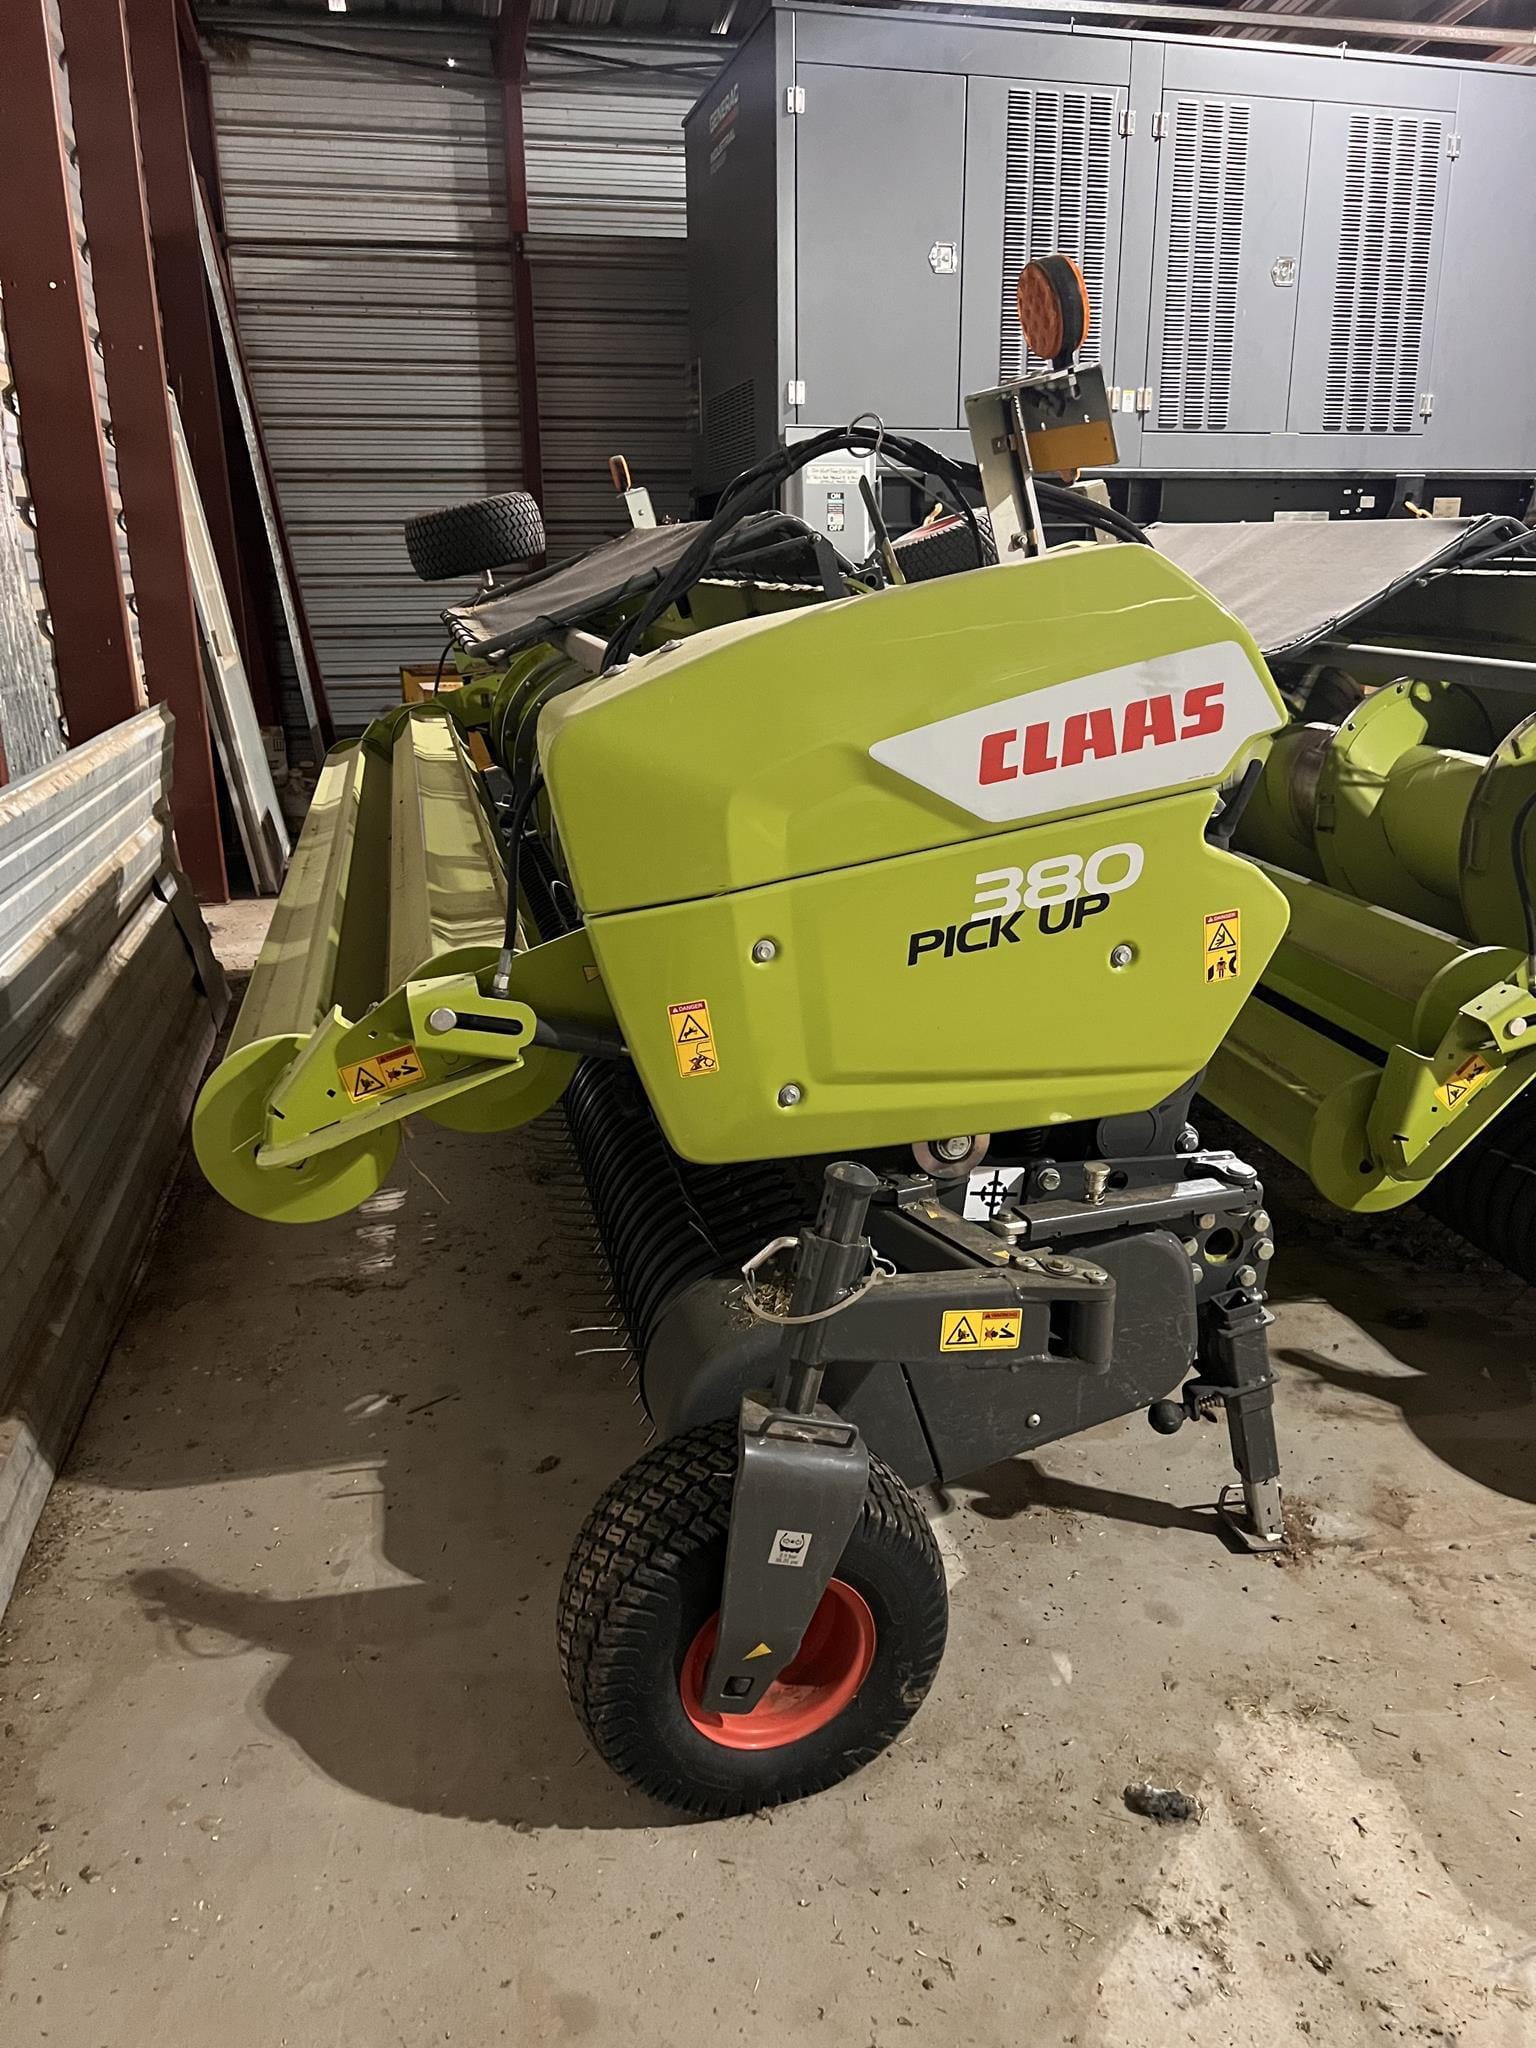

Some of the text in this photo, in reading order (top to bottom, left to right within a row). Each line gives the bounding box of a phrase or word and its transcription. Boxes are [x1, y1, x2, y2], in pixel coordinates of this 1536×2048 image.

[978, 682, 1225, 786] CLAAS
[973, 843, 1144, 920] 380
[908, 893, 1111, 966] PICK UP
[679, 1002, 703, 1012] DANGER
